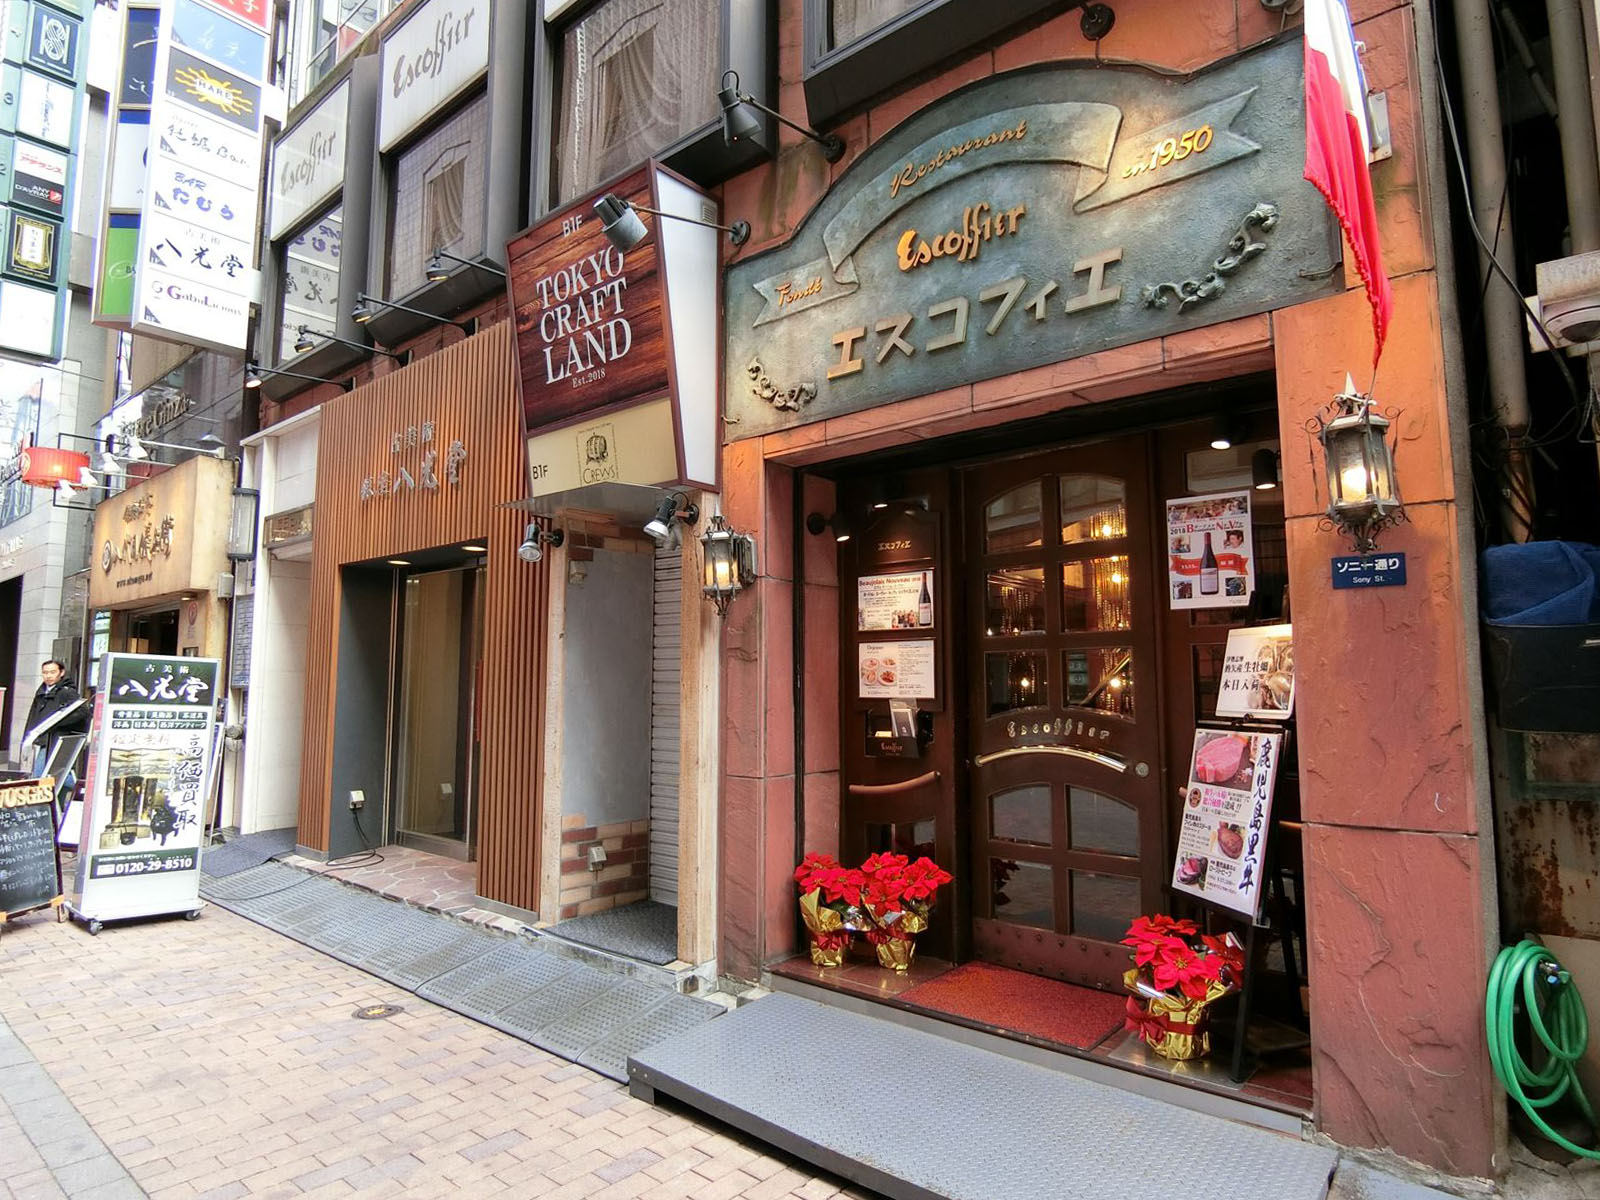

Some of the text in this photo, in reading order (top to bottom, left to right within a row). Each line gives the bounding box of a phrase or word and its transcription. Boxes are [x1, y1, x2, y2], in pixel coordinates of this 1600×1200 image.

[392, 7, 475, 98] Escoffier
[198, 80, 234, 101] HARE
[889, 119, 1028, 198] Restaurant
[1147, 124, 1214, 170] 1950
[280, 130, 336, 196] Escoffier
[174, 171, 206, 191] BAR
[562, 214, 583, 238] B1F
[896, 201, 1027, 272] Escoffier
[156, 237, 244, 279] 八光堂
[536, 244, 625, 310] TOKYO
[540, 277, 628, 343] CRAFT
[826, 246, 1124, 381] エスコフィエ
[543, 318, 633, 385] LAND
[532, 465, 548, 480] B1F
[583, 464, 616, 485] CREWS
[1337, 558, 1400, 572] ソニー通り
[1353, 575, 1371, 584] Sony
[145, 663, 190, 675] 古美術
[118, 674, 209, 703] 八光堂
[1007, 718, 1110, 739] Escoffier
[116, 858, 192, 874] 0120-29-8510
